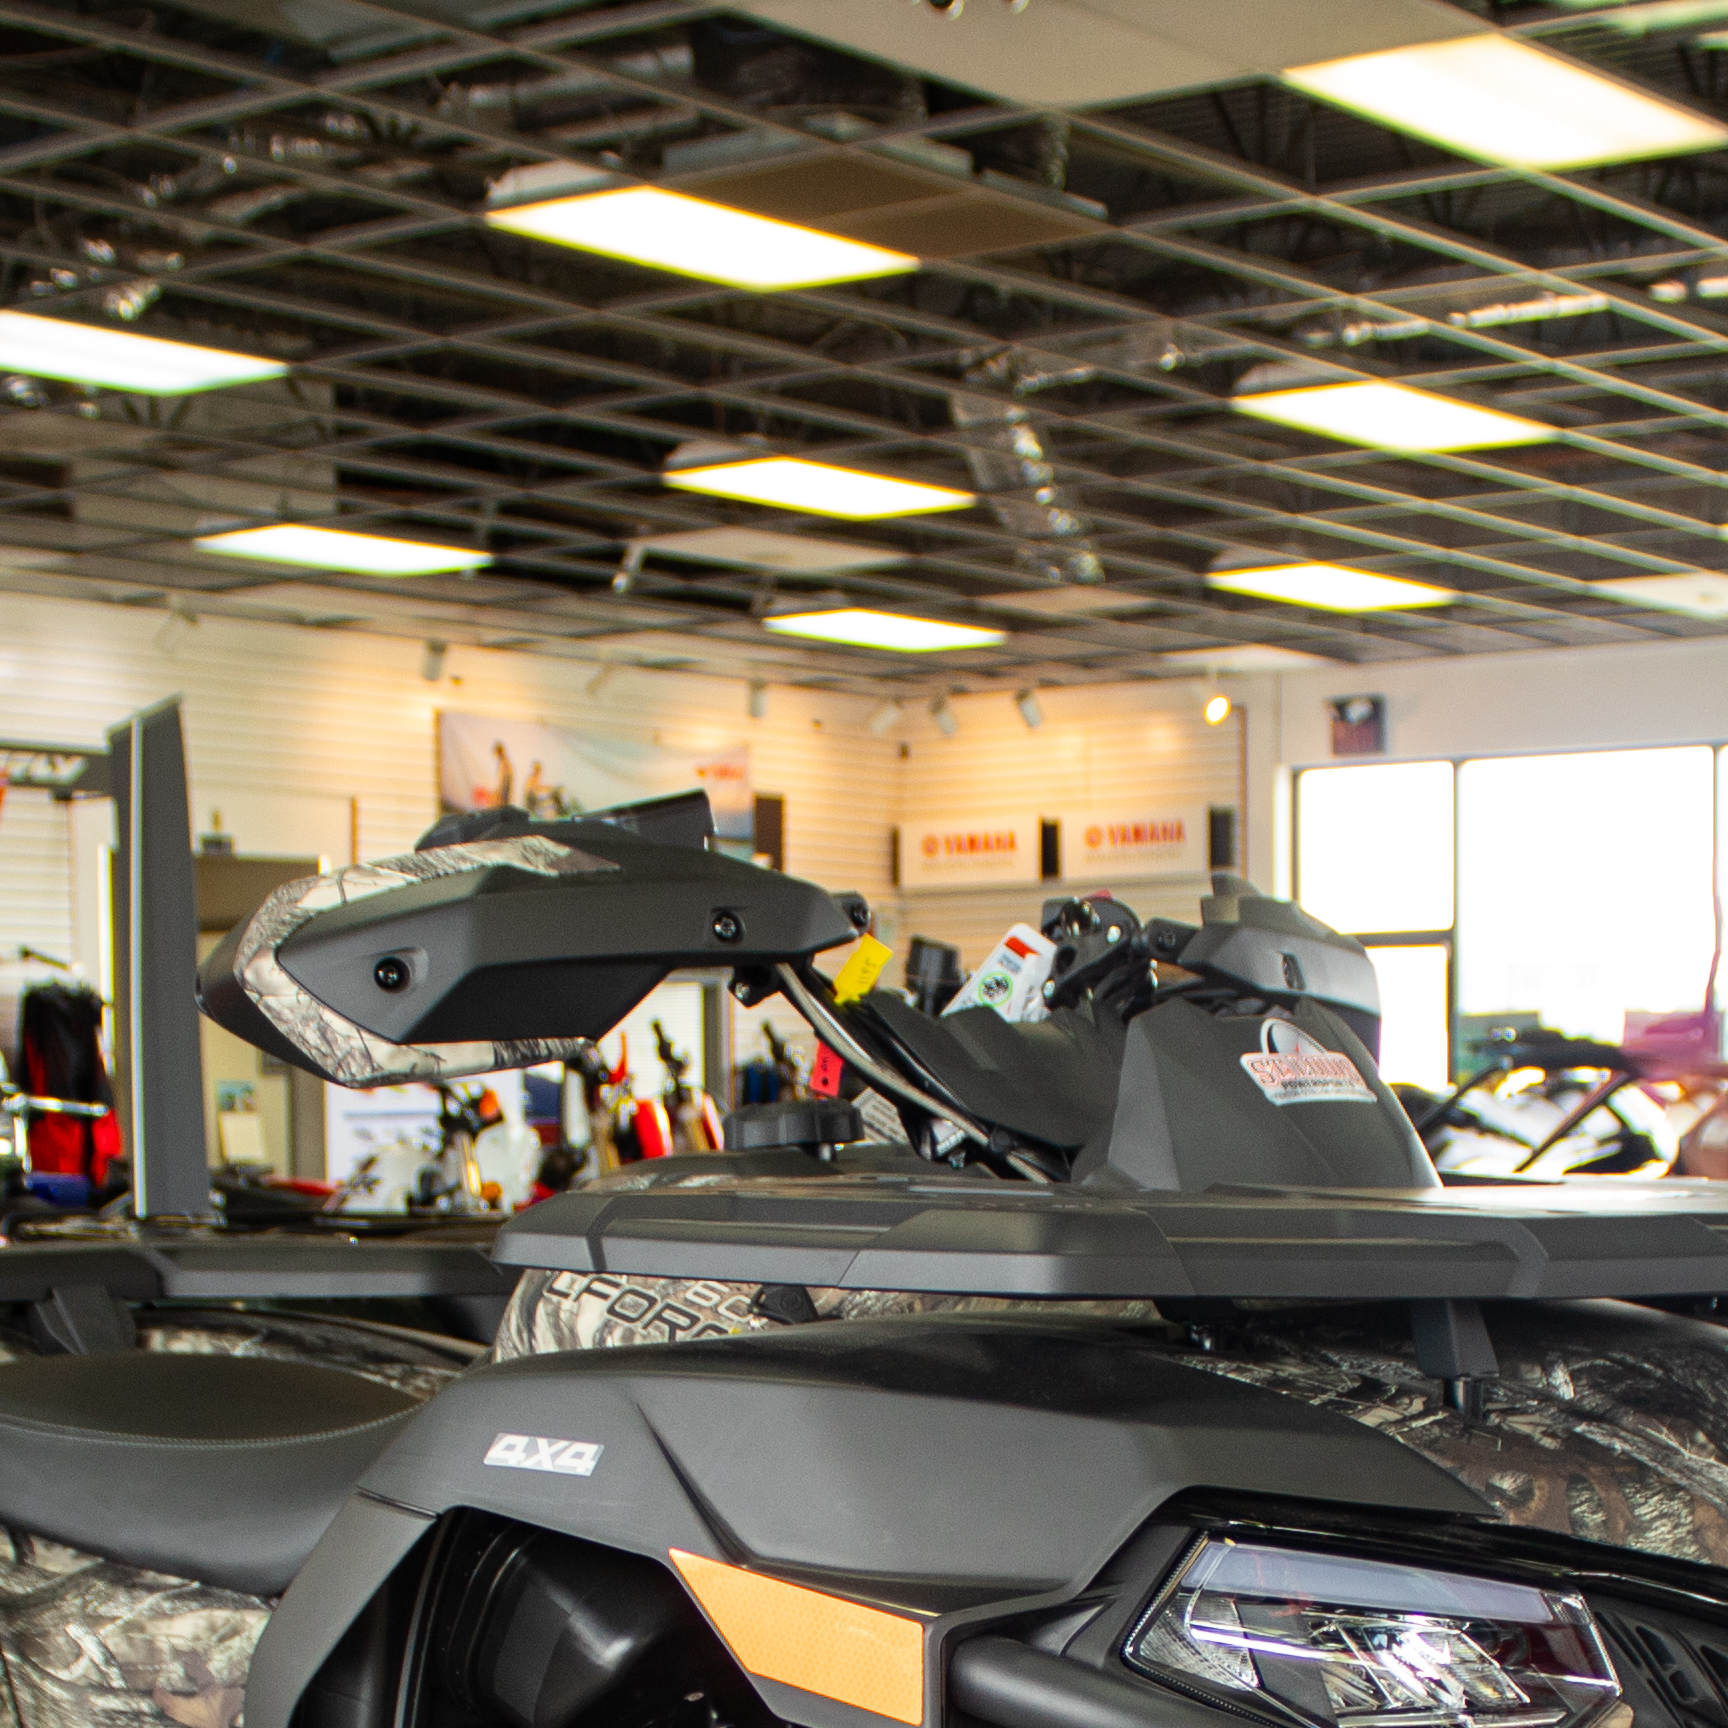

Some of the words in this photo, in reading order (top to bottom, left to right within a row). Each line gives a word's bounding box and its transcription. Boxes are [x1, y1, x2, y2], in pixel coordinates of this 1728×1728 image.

[944, 829, 1017, 856] YAMAHA
[1108, 819, 1185, 848] YAMAHA
[486, 1435, 600, 1474] 4X4
